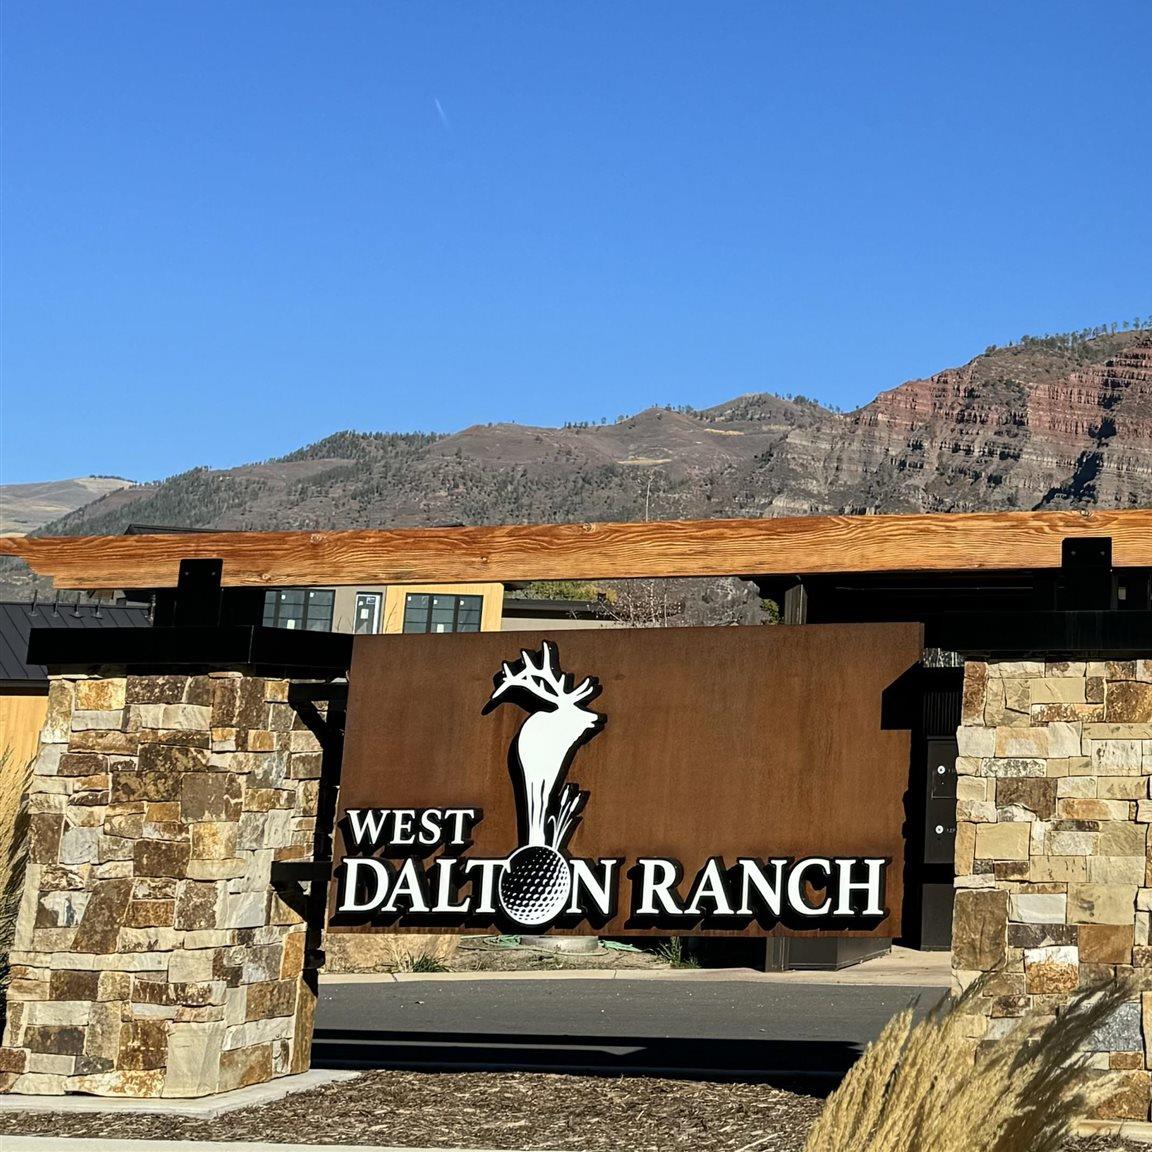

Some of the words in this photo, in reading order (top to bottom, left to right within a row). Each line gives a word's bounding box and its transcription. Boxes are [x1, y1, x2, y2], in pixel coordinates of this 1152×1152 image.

[346, 809, 476, 845] WEST
[338, 847, 617, 925] DALTON
[636, 858, 886, 916] RANCH
